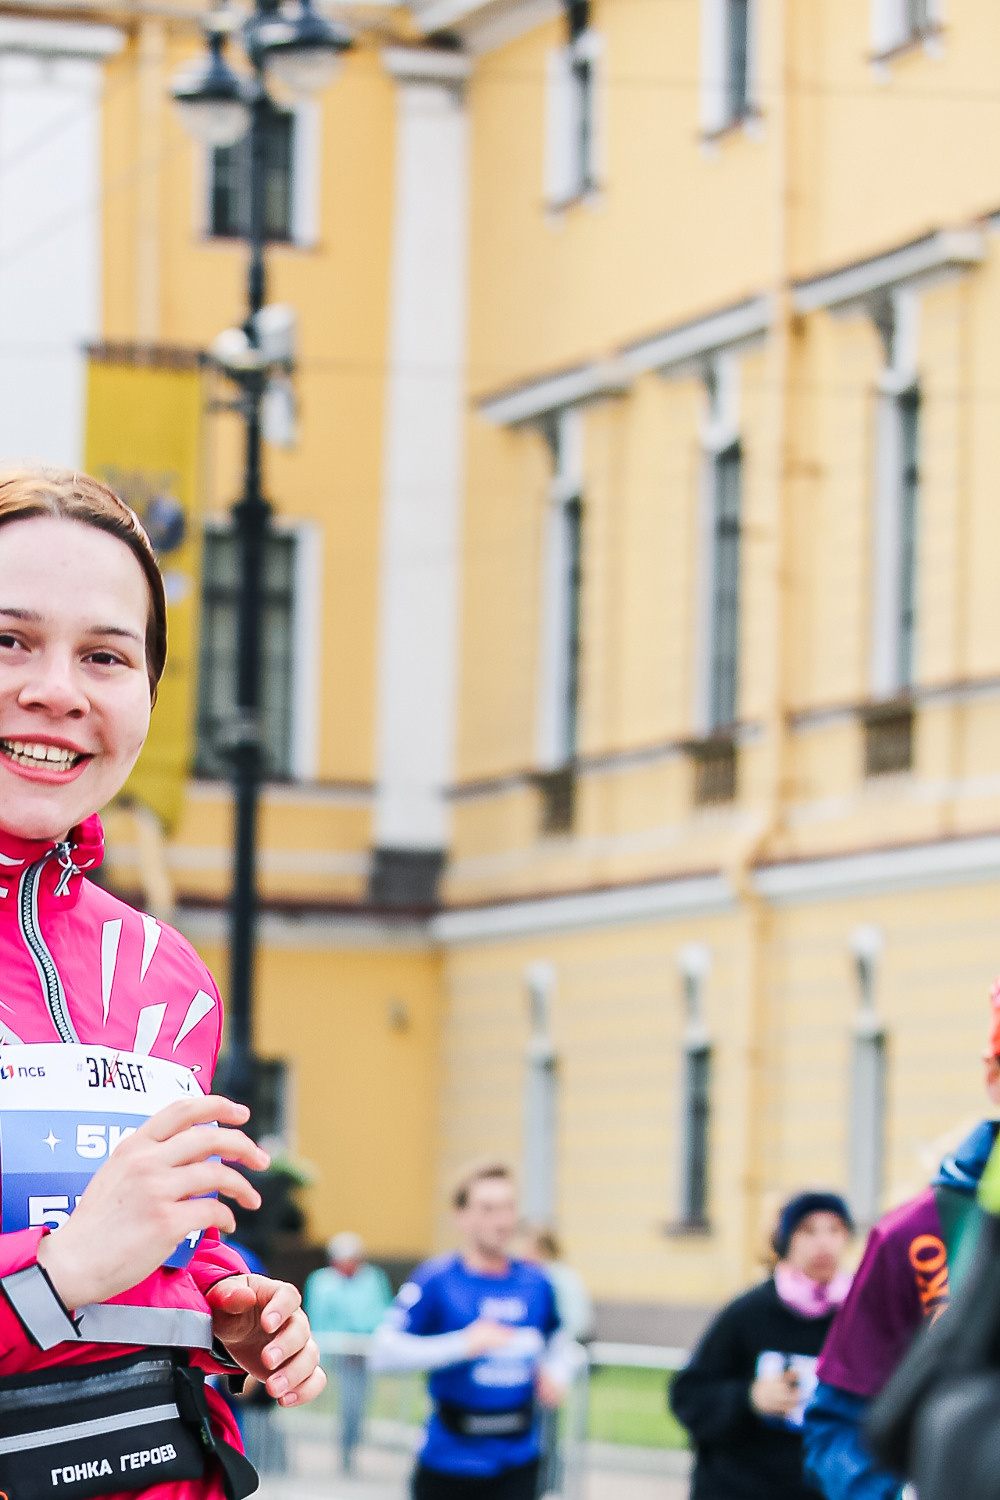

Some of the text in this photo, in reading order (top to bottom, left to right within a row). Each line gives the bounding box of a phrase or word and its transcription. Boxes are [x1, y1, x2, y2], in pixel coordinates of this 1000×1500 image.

[18, 1066, 46, 1077] ПСБ
[51, 1443, 177, 1486] ГОНКА ГЕРОЕВ
